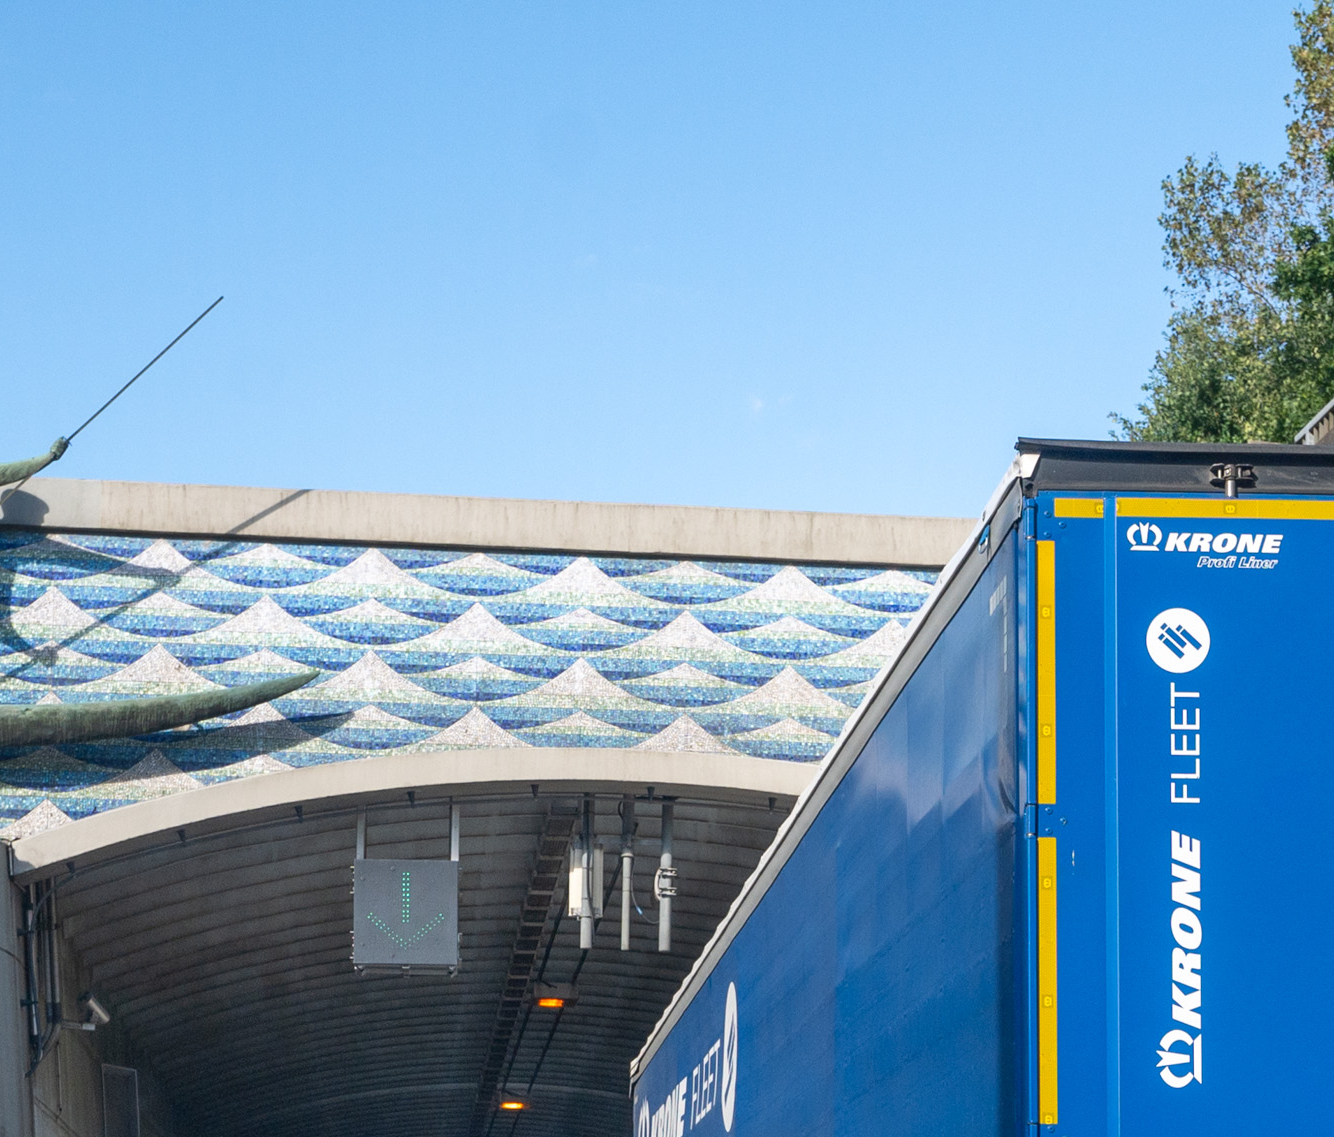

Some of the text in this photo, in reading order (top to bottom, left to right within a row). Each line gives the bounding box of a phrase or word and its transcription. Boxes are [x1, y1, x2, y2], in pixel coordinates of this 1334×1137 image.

[1165, 532, 1284, 553] KRONE
[1197, 556, 1278, 569] Profi Liner
[1170, 682, 1203, 1029] KRONE FLEET
[690, 1038, 720, 1130] FLEET
